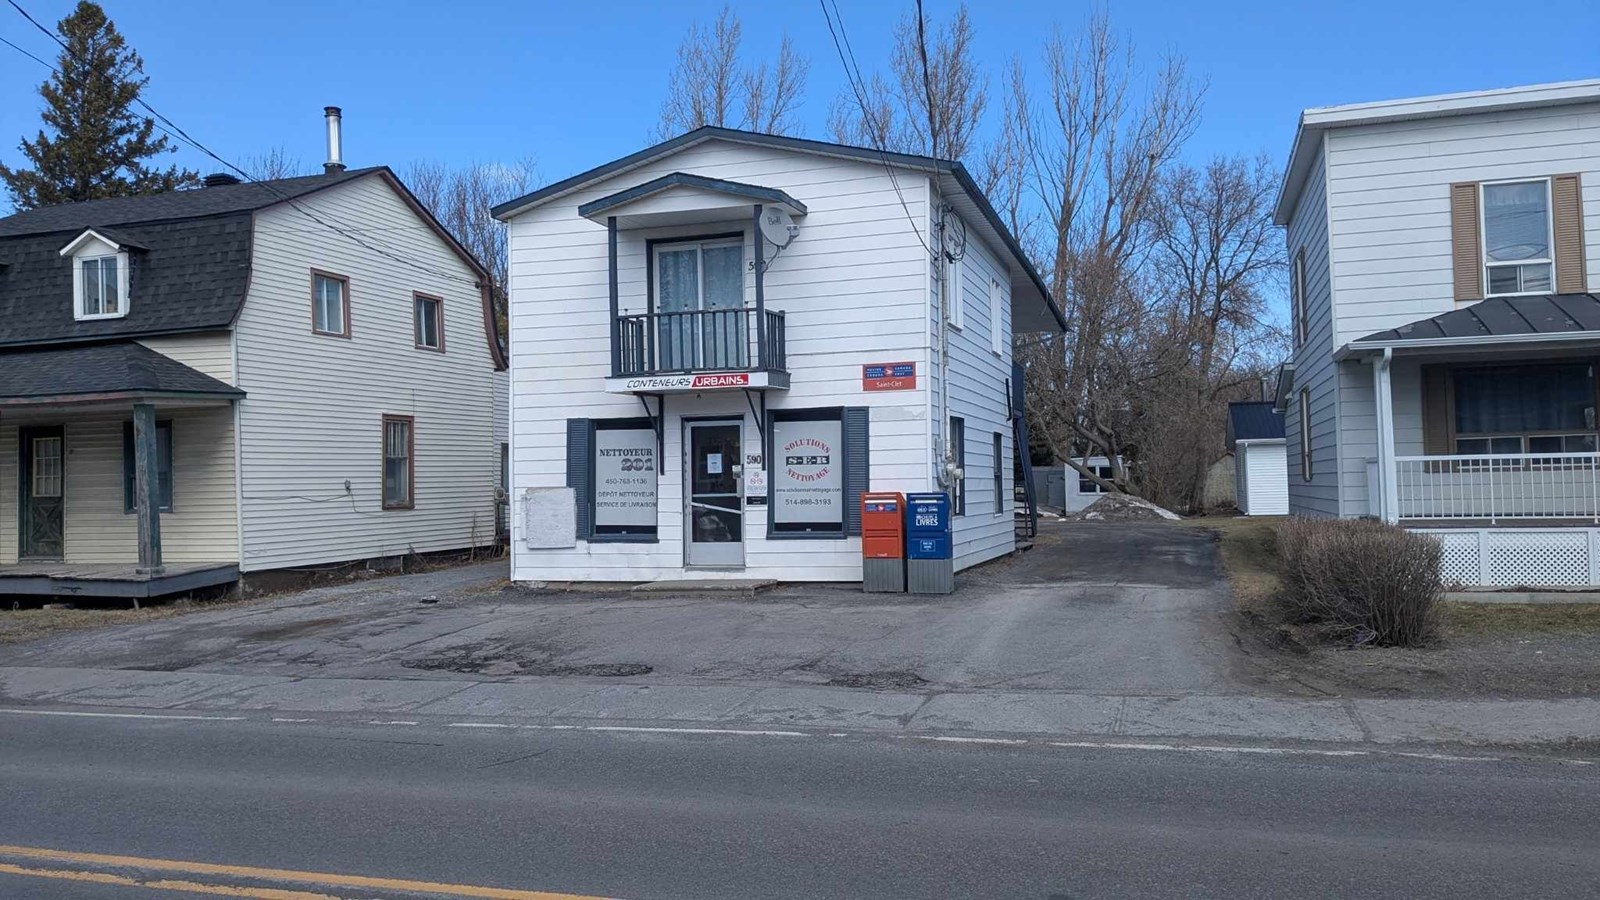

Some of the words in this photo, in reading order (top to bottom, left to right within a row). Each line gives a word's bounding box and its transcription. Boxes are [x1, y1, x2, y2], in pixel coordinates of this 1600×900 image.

[767, 216, 782, 226] Bell
[626, 378, 691, 389] CONTENEURS
[695, 375, 744, 386] URBAINS
[784, 438, 831, 454] SOLUTIONS
[599, 448, 653, 457] NETTOYEUR
[621, 458, 654, 471] 201
[746, 454, 762, 465] 590
[786, 466, 830, 482] NETTOYAGE
[915, 518, 939, 526] LIVRES
